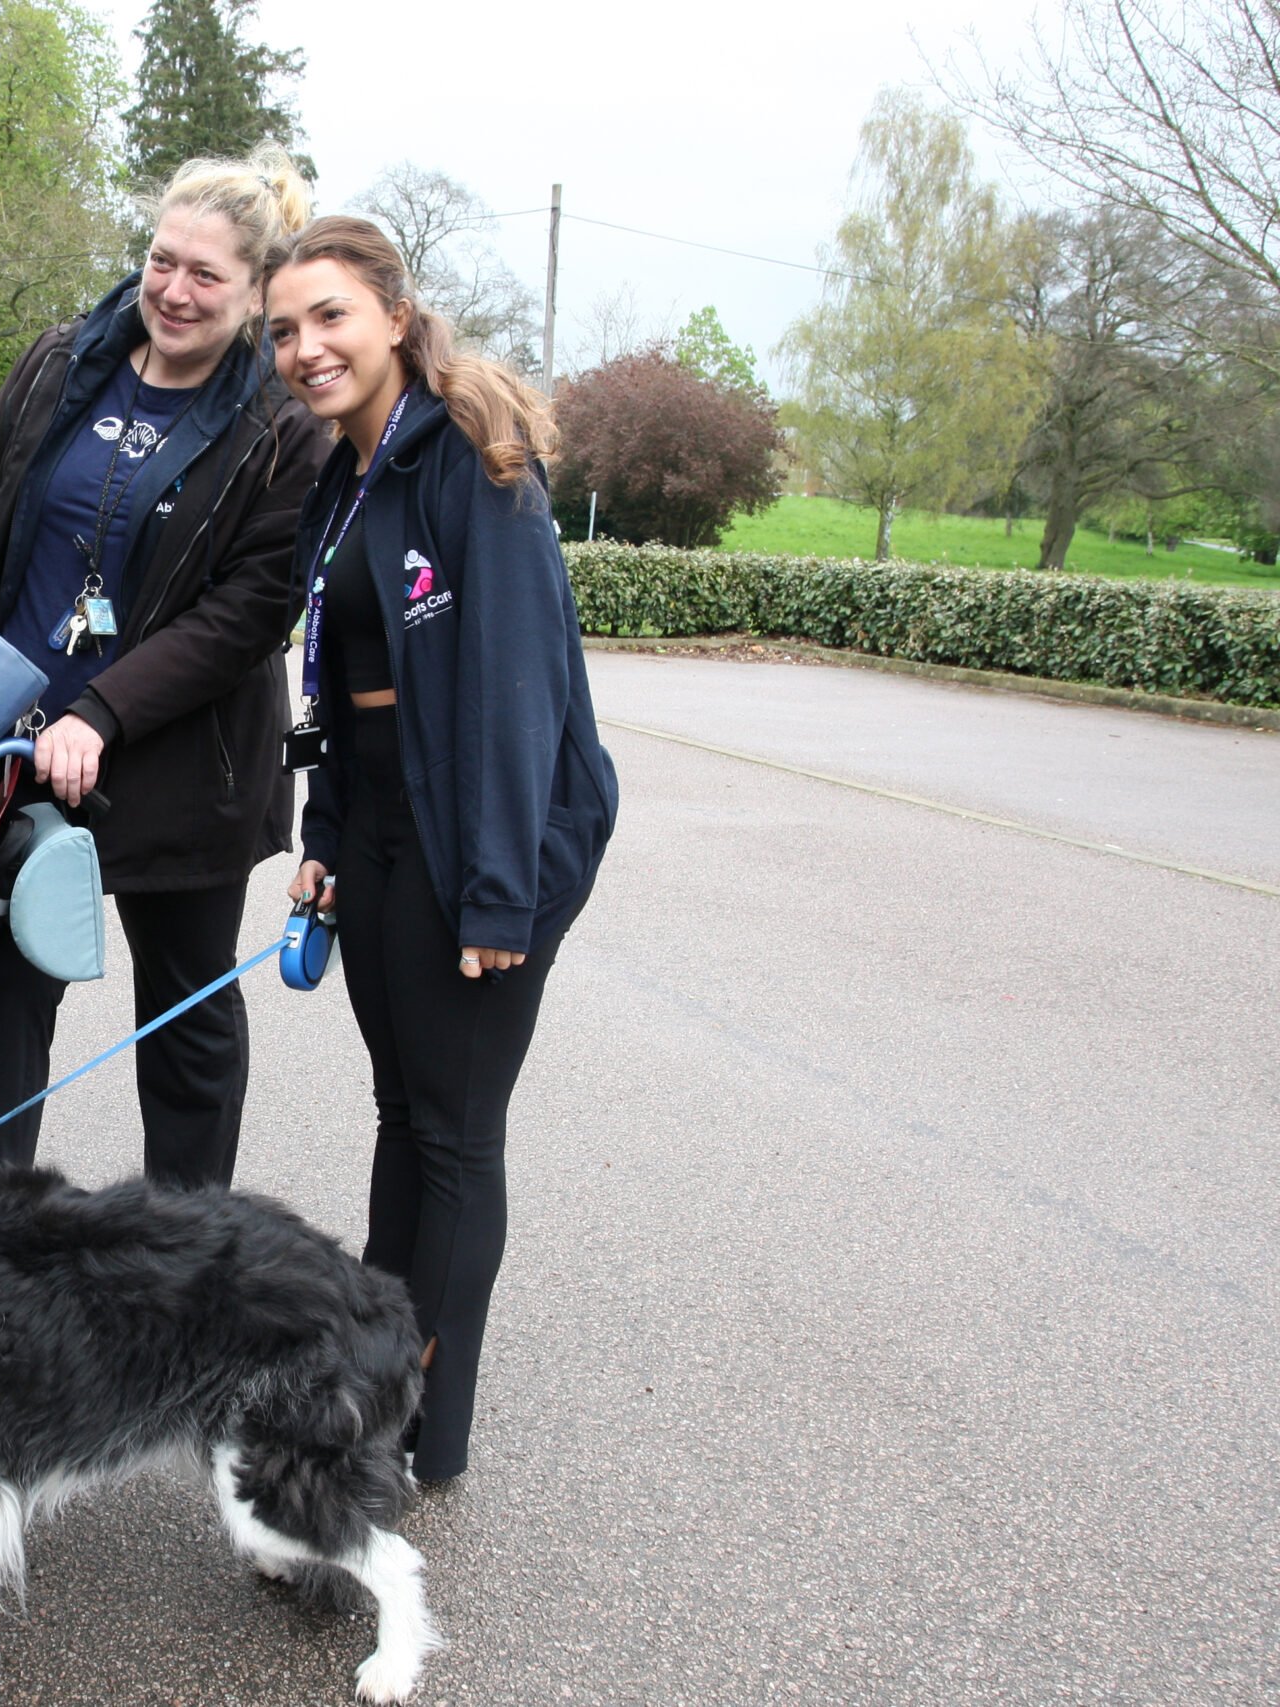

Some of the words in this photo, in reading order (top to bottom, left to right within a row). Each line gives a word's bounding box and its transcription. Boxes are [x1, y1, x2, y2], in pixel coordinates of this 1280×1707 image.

[381, 423, 397, 446] Care
[155, 501, 175, 513] Ab
[310, 607, 321, 640] Abbots
[308, 640, 318, 663] Care
